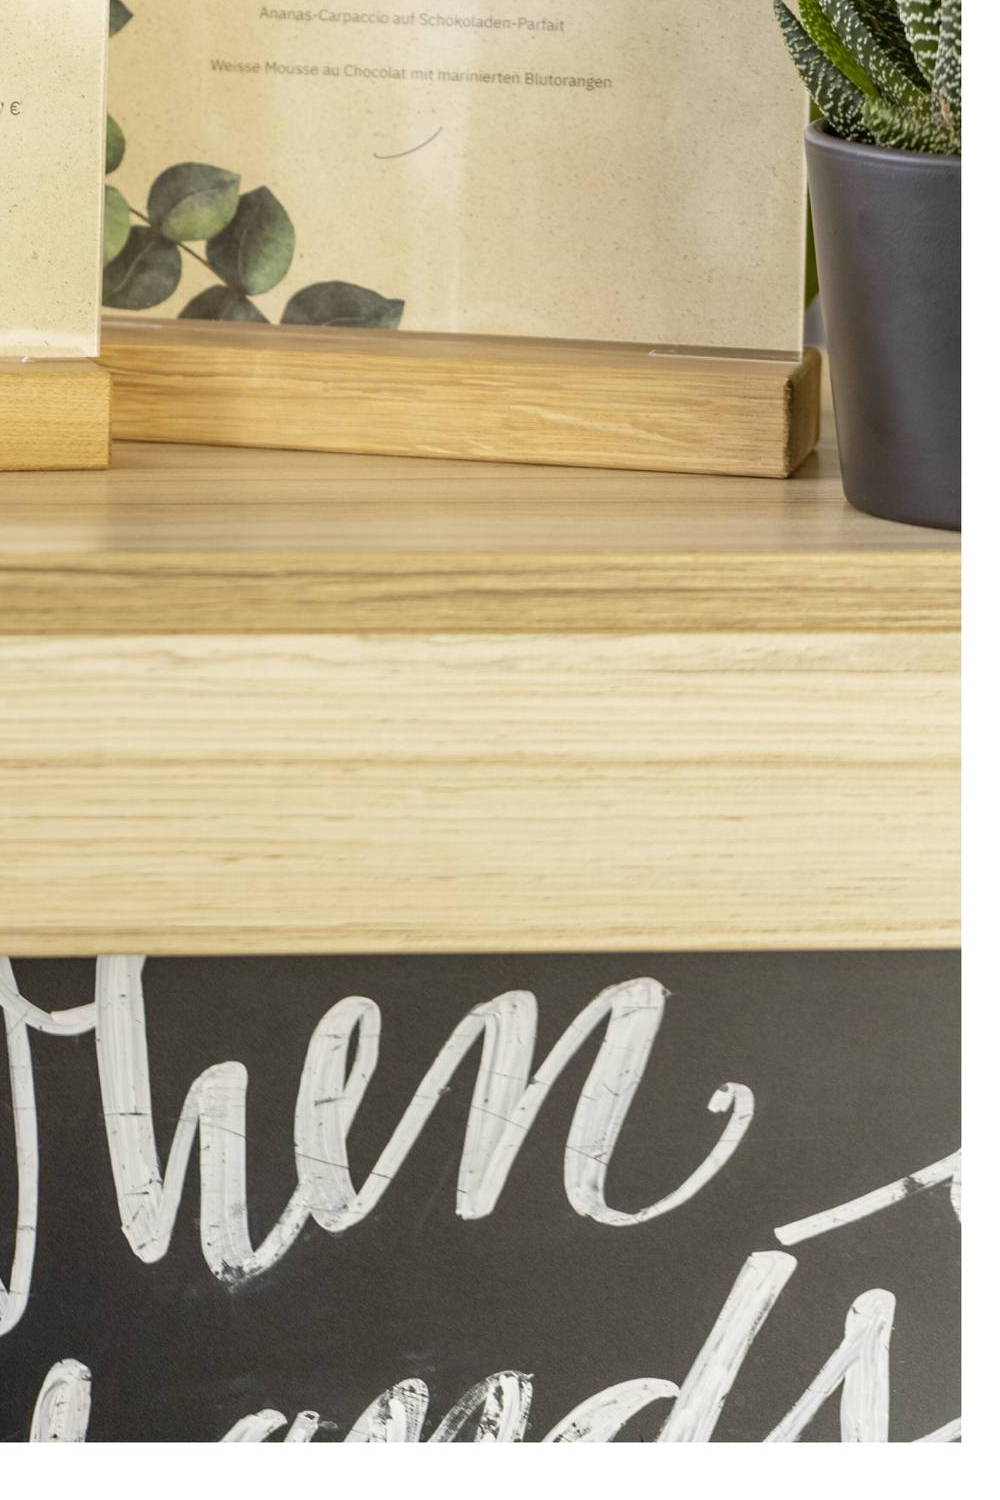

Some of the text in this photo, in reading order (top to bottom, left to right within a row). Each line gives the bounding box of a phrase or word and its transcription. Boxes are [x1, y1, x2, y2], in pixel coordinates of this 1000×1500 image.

[258, 6, 565, 31] Ananas-Carpaccio auf Schokoladen-Parfait
[209, 59, 613, 91] Weisse Mousse au Chocolat mit marinierten Blutorangen
